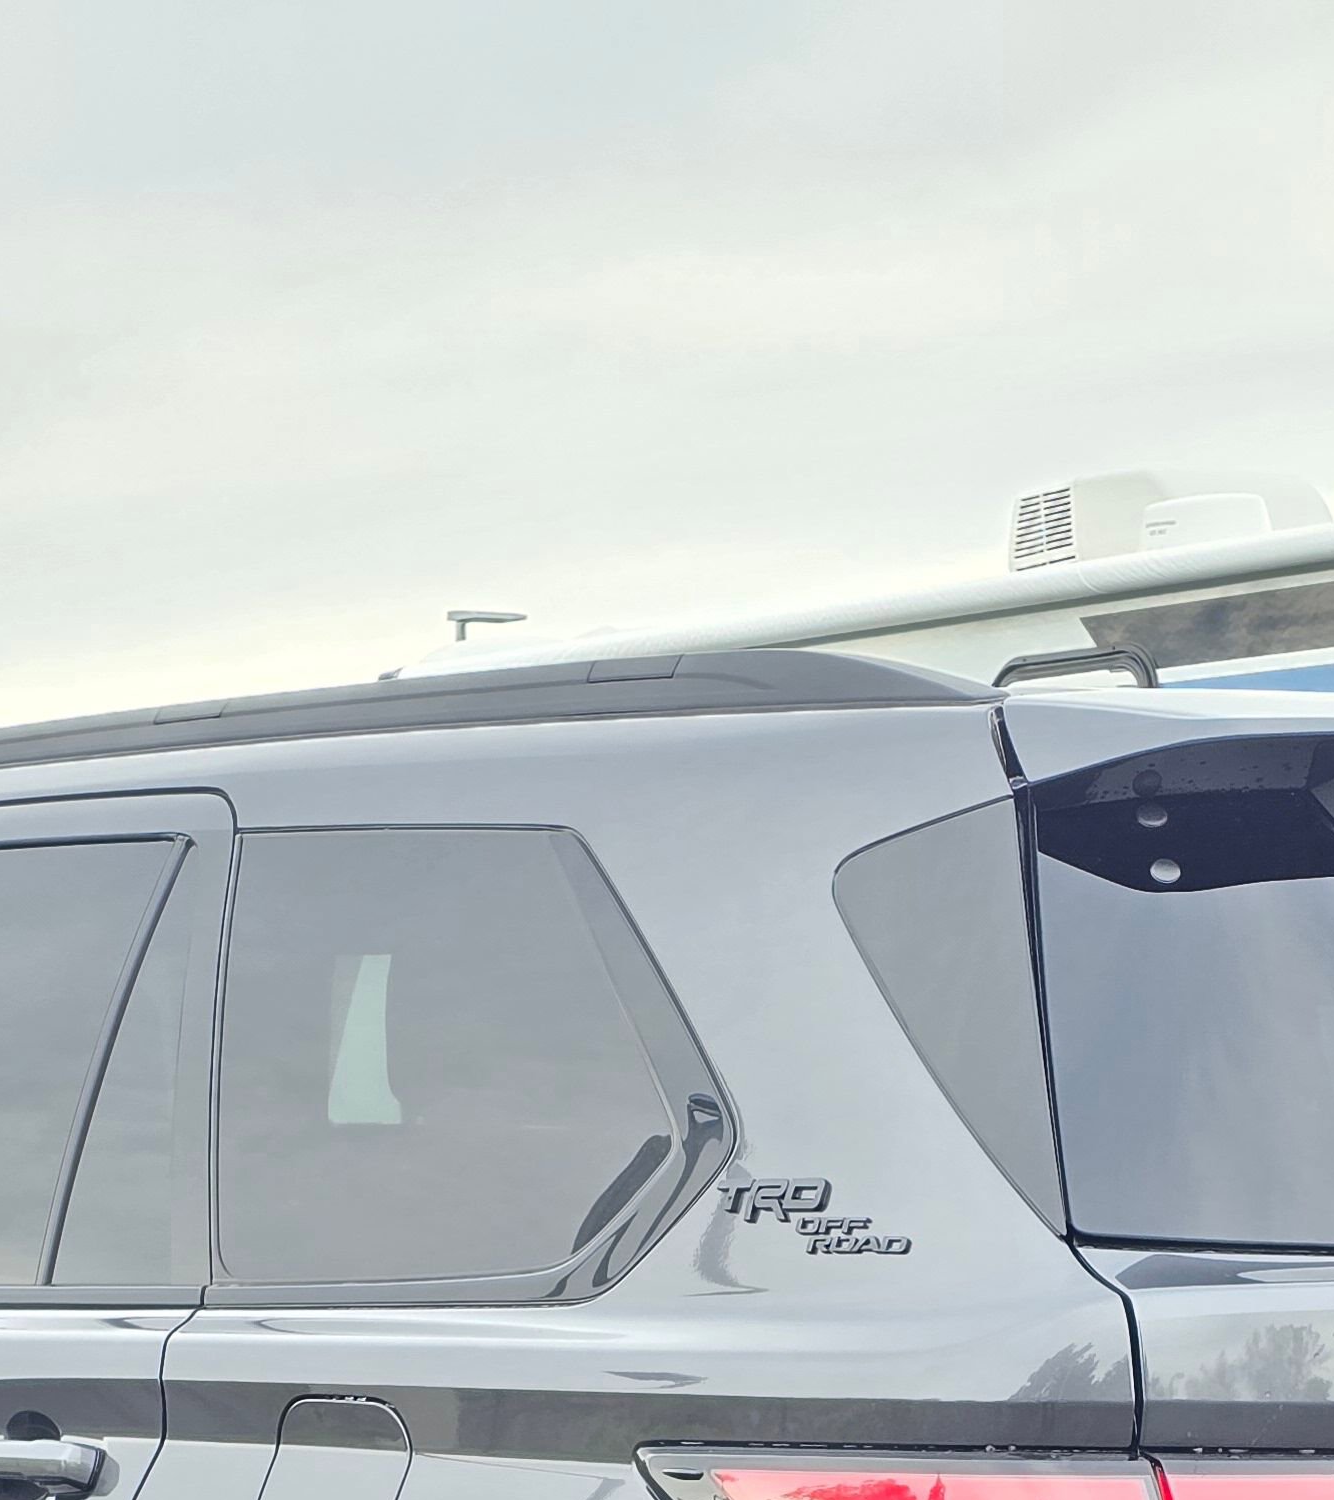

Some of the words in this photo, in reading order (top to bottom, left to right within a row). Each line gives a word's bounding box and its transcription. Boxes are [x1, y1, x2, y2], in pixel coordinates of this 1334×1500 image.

[717, 1178, 833, 1223] TRD
[795, 1217, 873, 1236] OFF
[805, 1235, 913, 1255] ROAD
